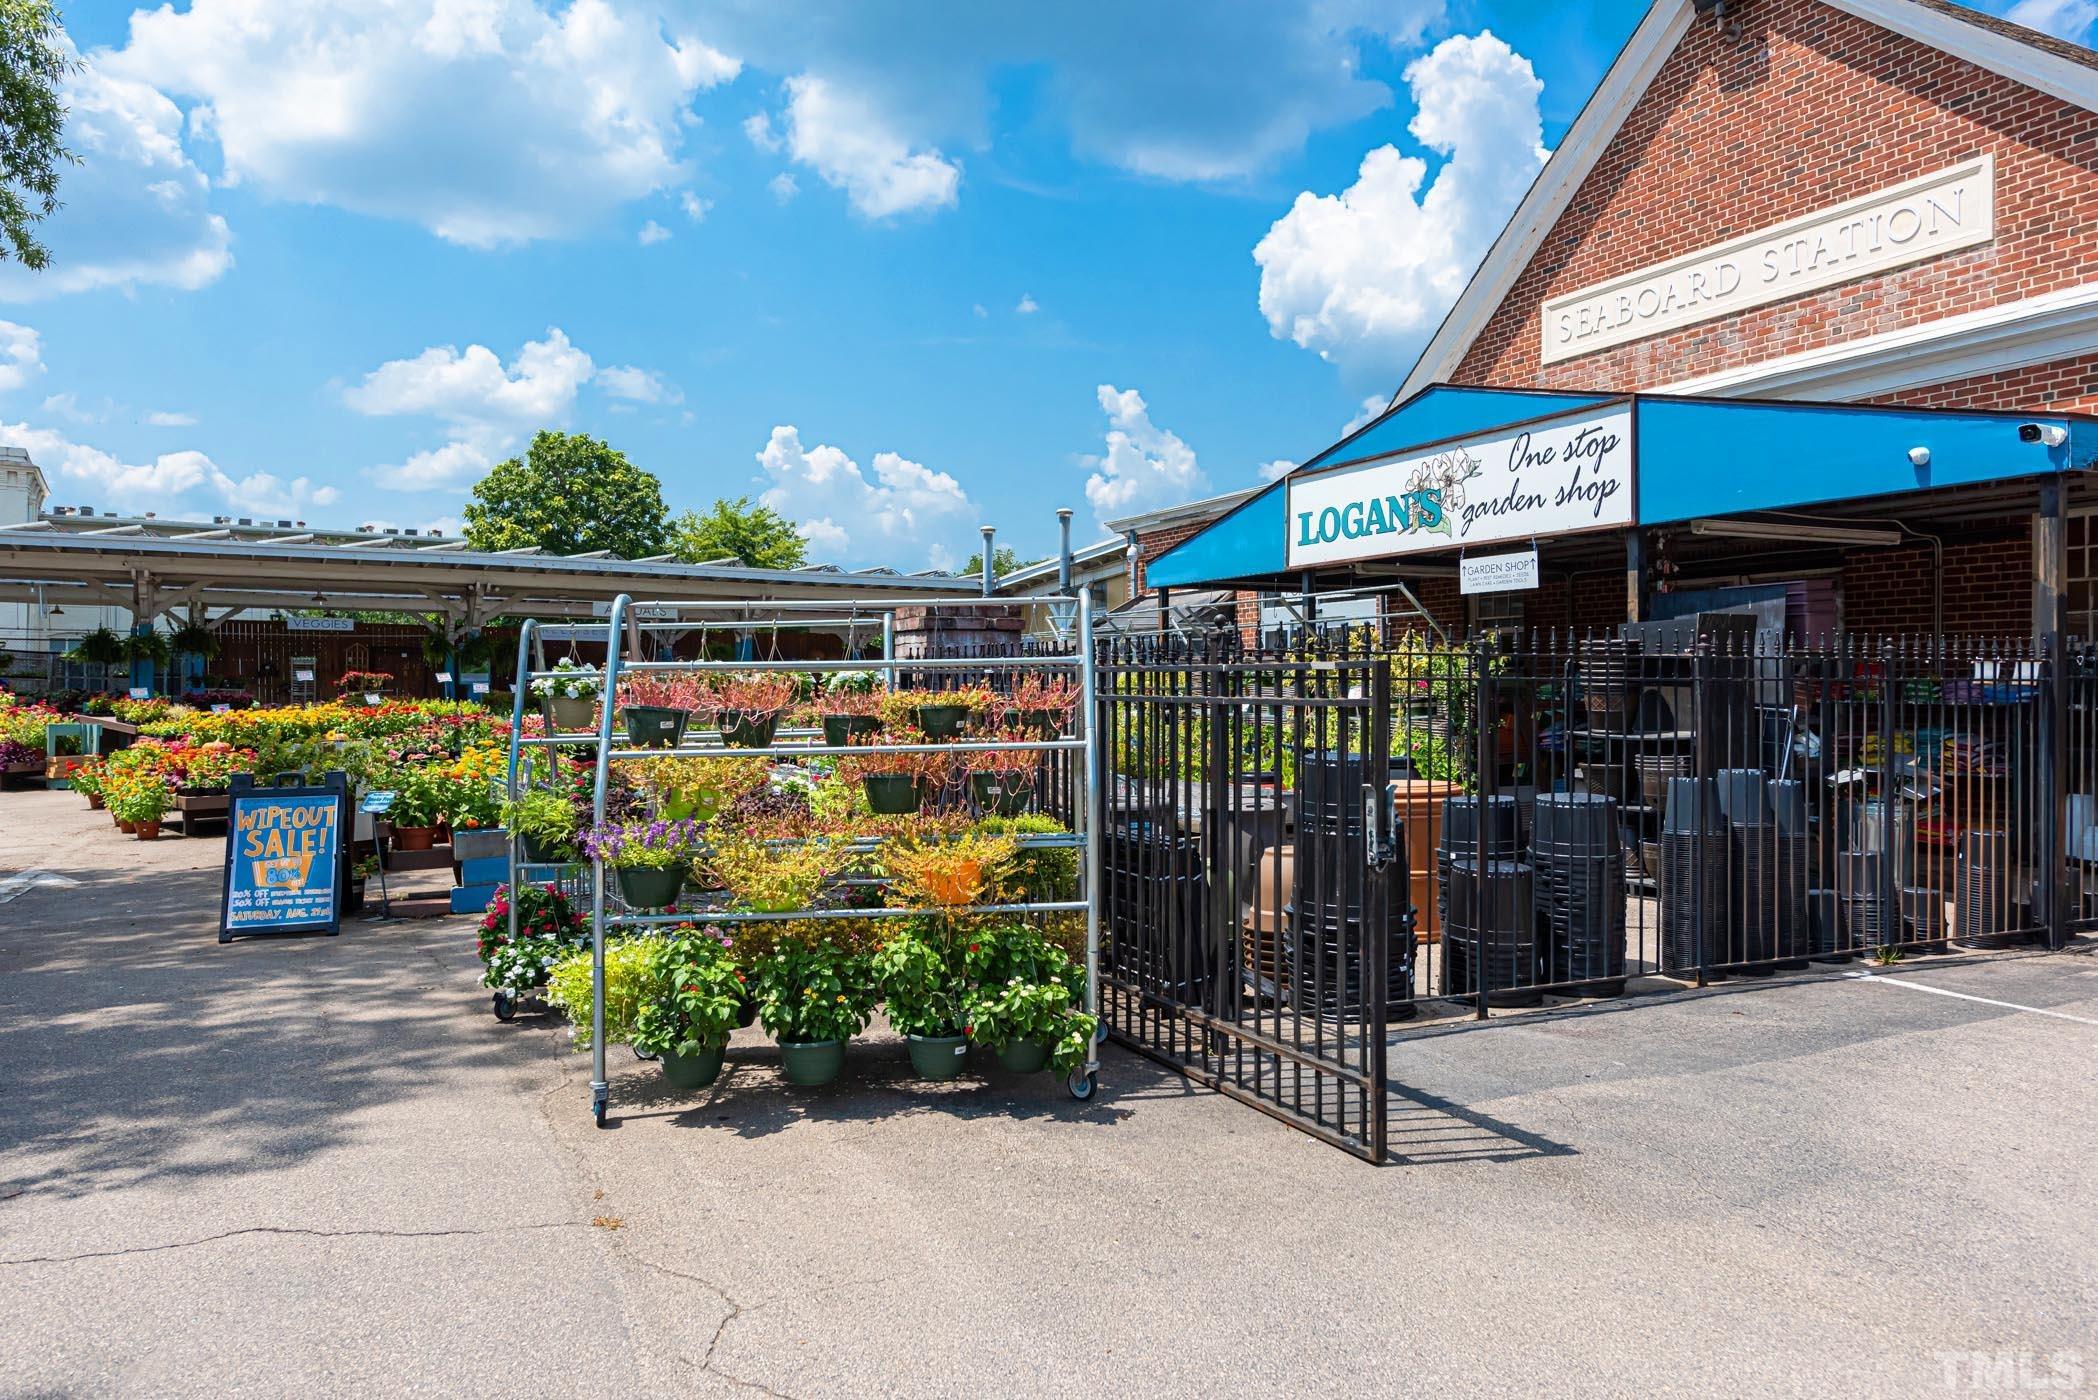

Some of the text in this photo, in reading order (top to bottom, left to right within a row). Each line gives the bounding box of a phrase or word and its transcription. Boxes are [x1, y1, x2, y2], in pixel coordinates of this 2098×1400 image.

[1560, 188, 1964, 343] SEABOARD STATION
[1508, 426, 1621, 474] One stop
[1461, 465, 1621, 537] garden shop
[1297, 487, 1443, 546] LOGAN'S
[1467, 560, 1530, 576] GARDEN SHOP
[294, 619, 349, 629] VEGGIES
[236, 805, 337, 831] WIPEOUT
[243, 828, 328, 858] SALE!
[266, 867, 302, 885] 80%
[253, 888, 270, 898] OFF
[255, 897, 271, 907] OFF
